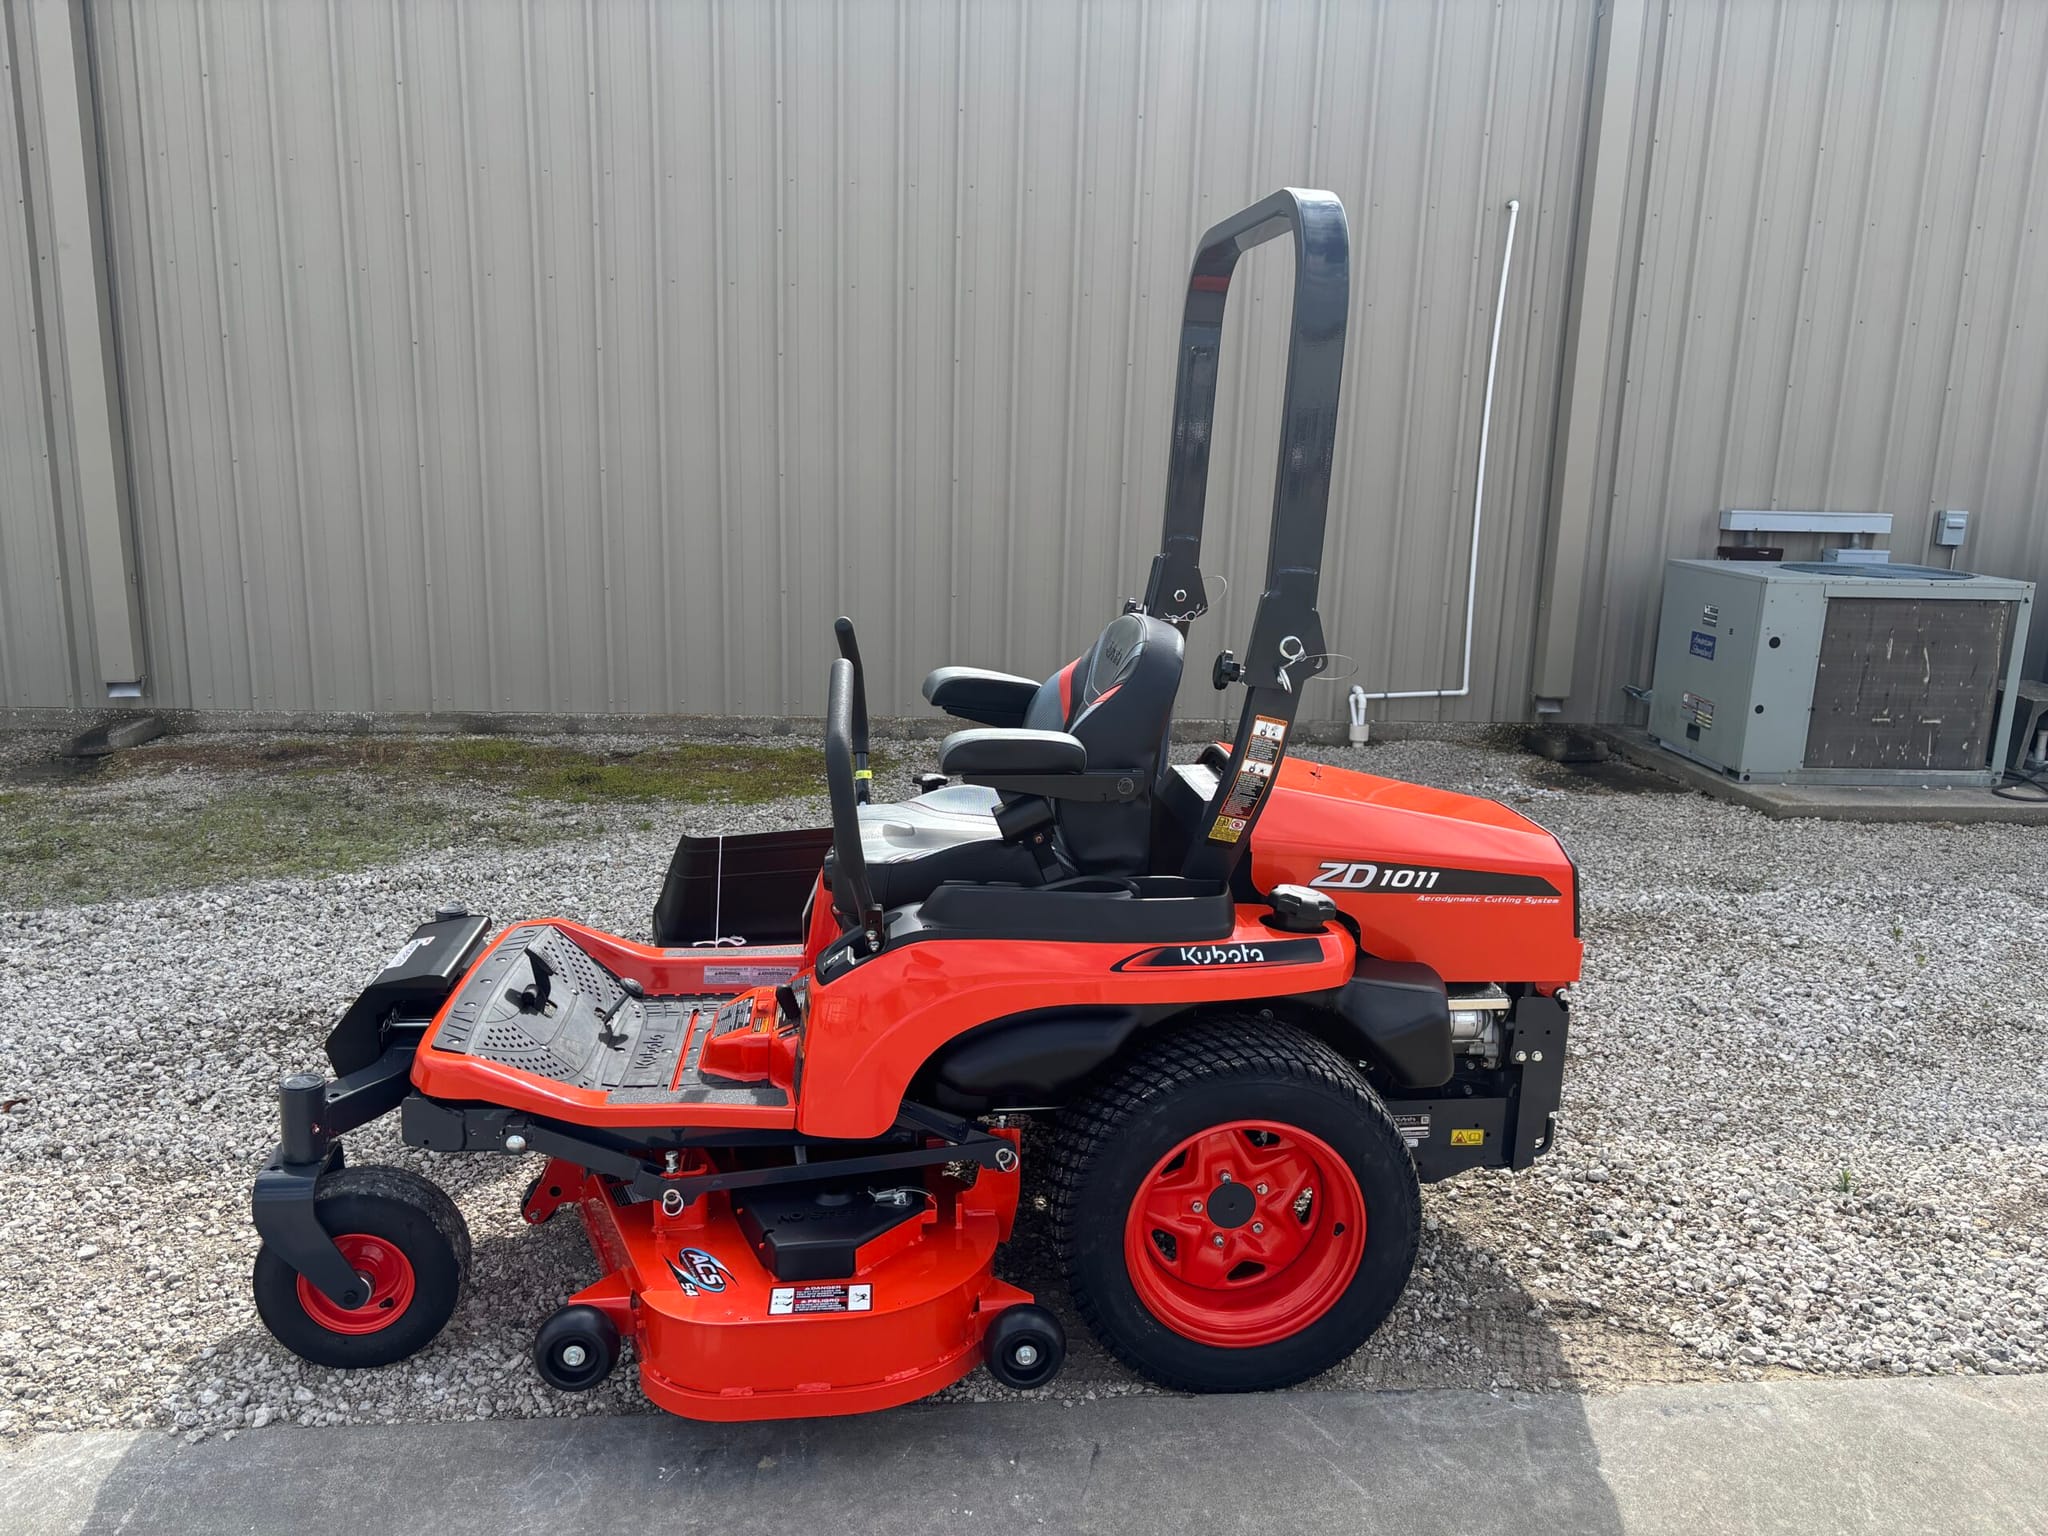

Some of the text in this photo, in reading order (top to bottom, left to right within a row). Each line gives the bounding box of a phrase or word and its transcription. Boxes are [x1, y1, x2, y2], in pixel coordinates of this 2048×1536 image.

[1416, 894, 1559, 905] Aerodynamic Cutting System
[1180, 943, 1264, 965] Kubota
[634, 1034, 665, 1069] Kubota
[687, 1253, 724, 1285] ACS
[680, 1282, 699, 1296] 54
